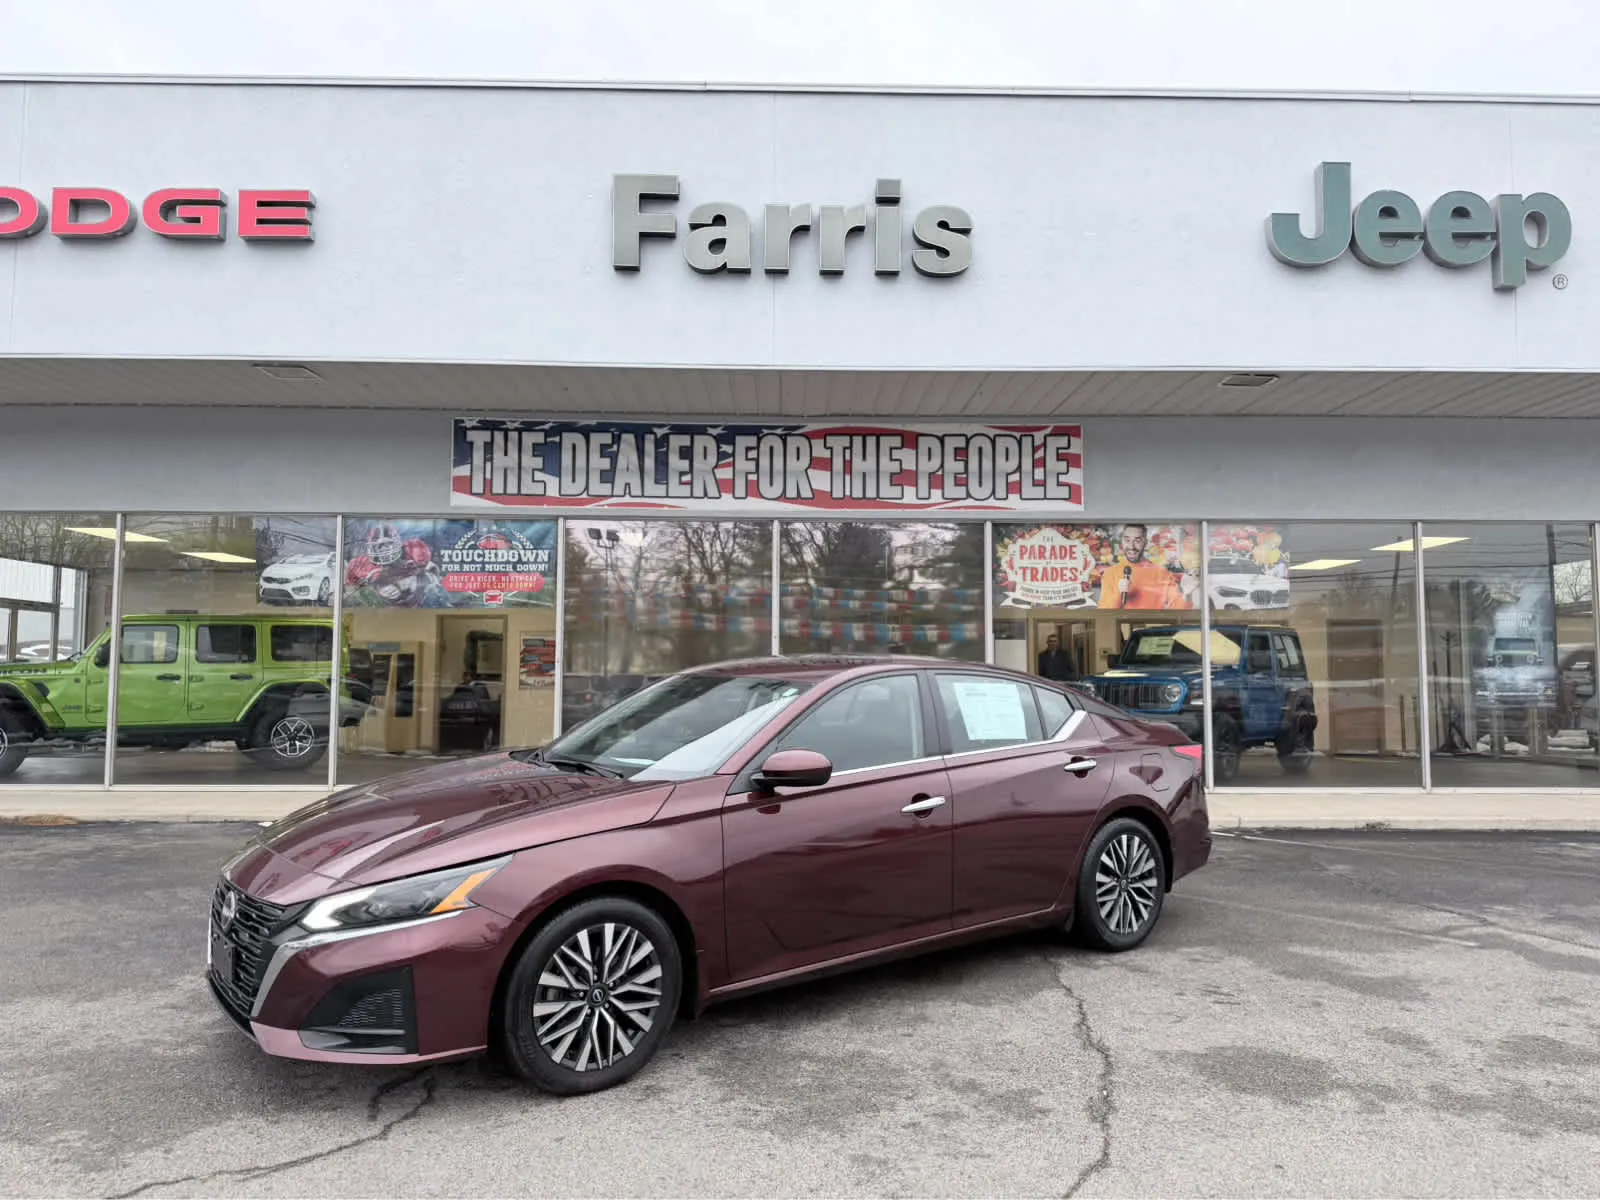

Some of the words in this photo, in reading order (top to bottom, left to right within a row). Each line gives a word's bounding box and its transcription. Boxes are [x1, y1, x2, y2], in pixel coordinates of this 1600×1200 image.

[612, 174, 974, 277] Farris
[1265, 161, 1572, 290] Jeep
[466, 429, 547, 497] THE
[559, 431, 722, 499] DEALER
[733, 432, 814, 500] FOR
[824, 433, 904, 500] THE
[916, 433, 1071, 500] PEOPLE
[440, 549, 550, 563] TOUCHDOWN
[1019, 545, 1077, 560] PARADE
[441, 563, 461, 572] FOR
[463, 563, 482, 572] NOT
[484, 563, 514, 572] MUCH
[516, 563, 549, 572] DOWN!
[1021, 567, 1079, 582] TRADES
